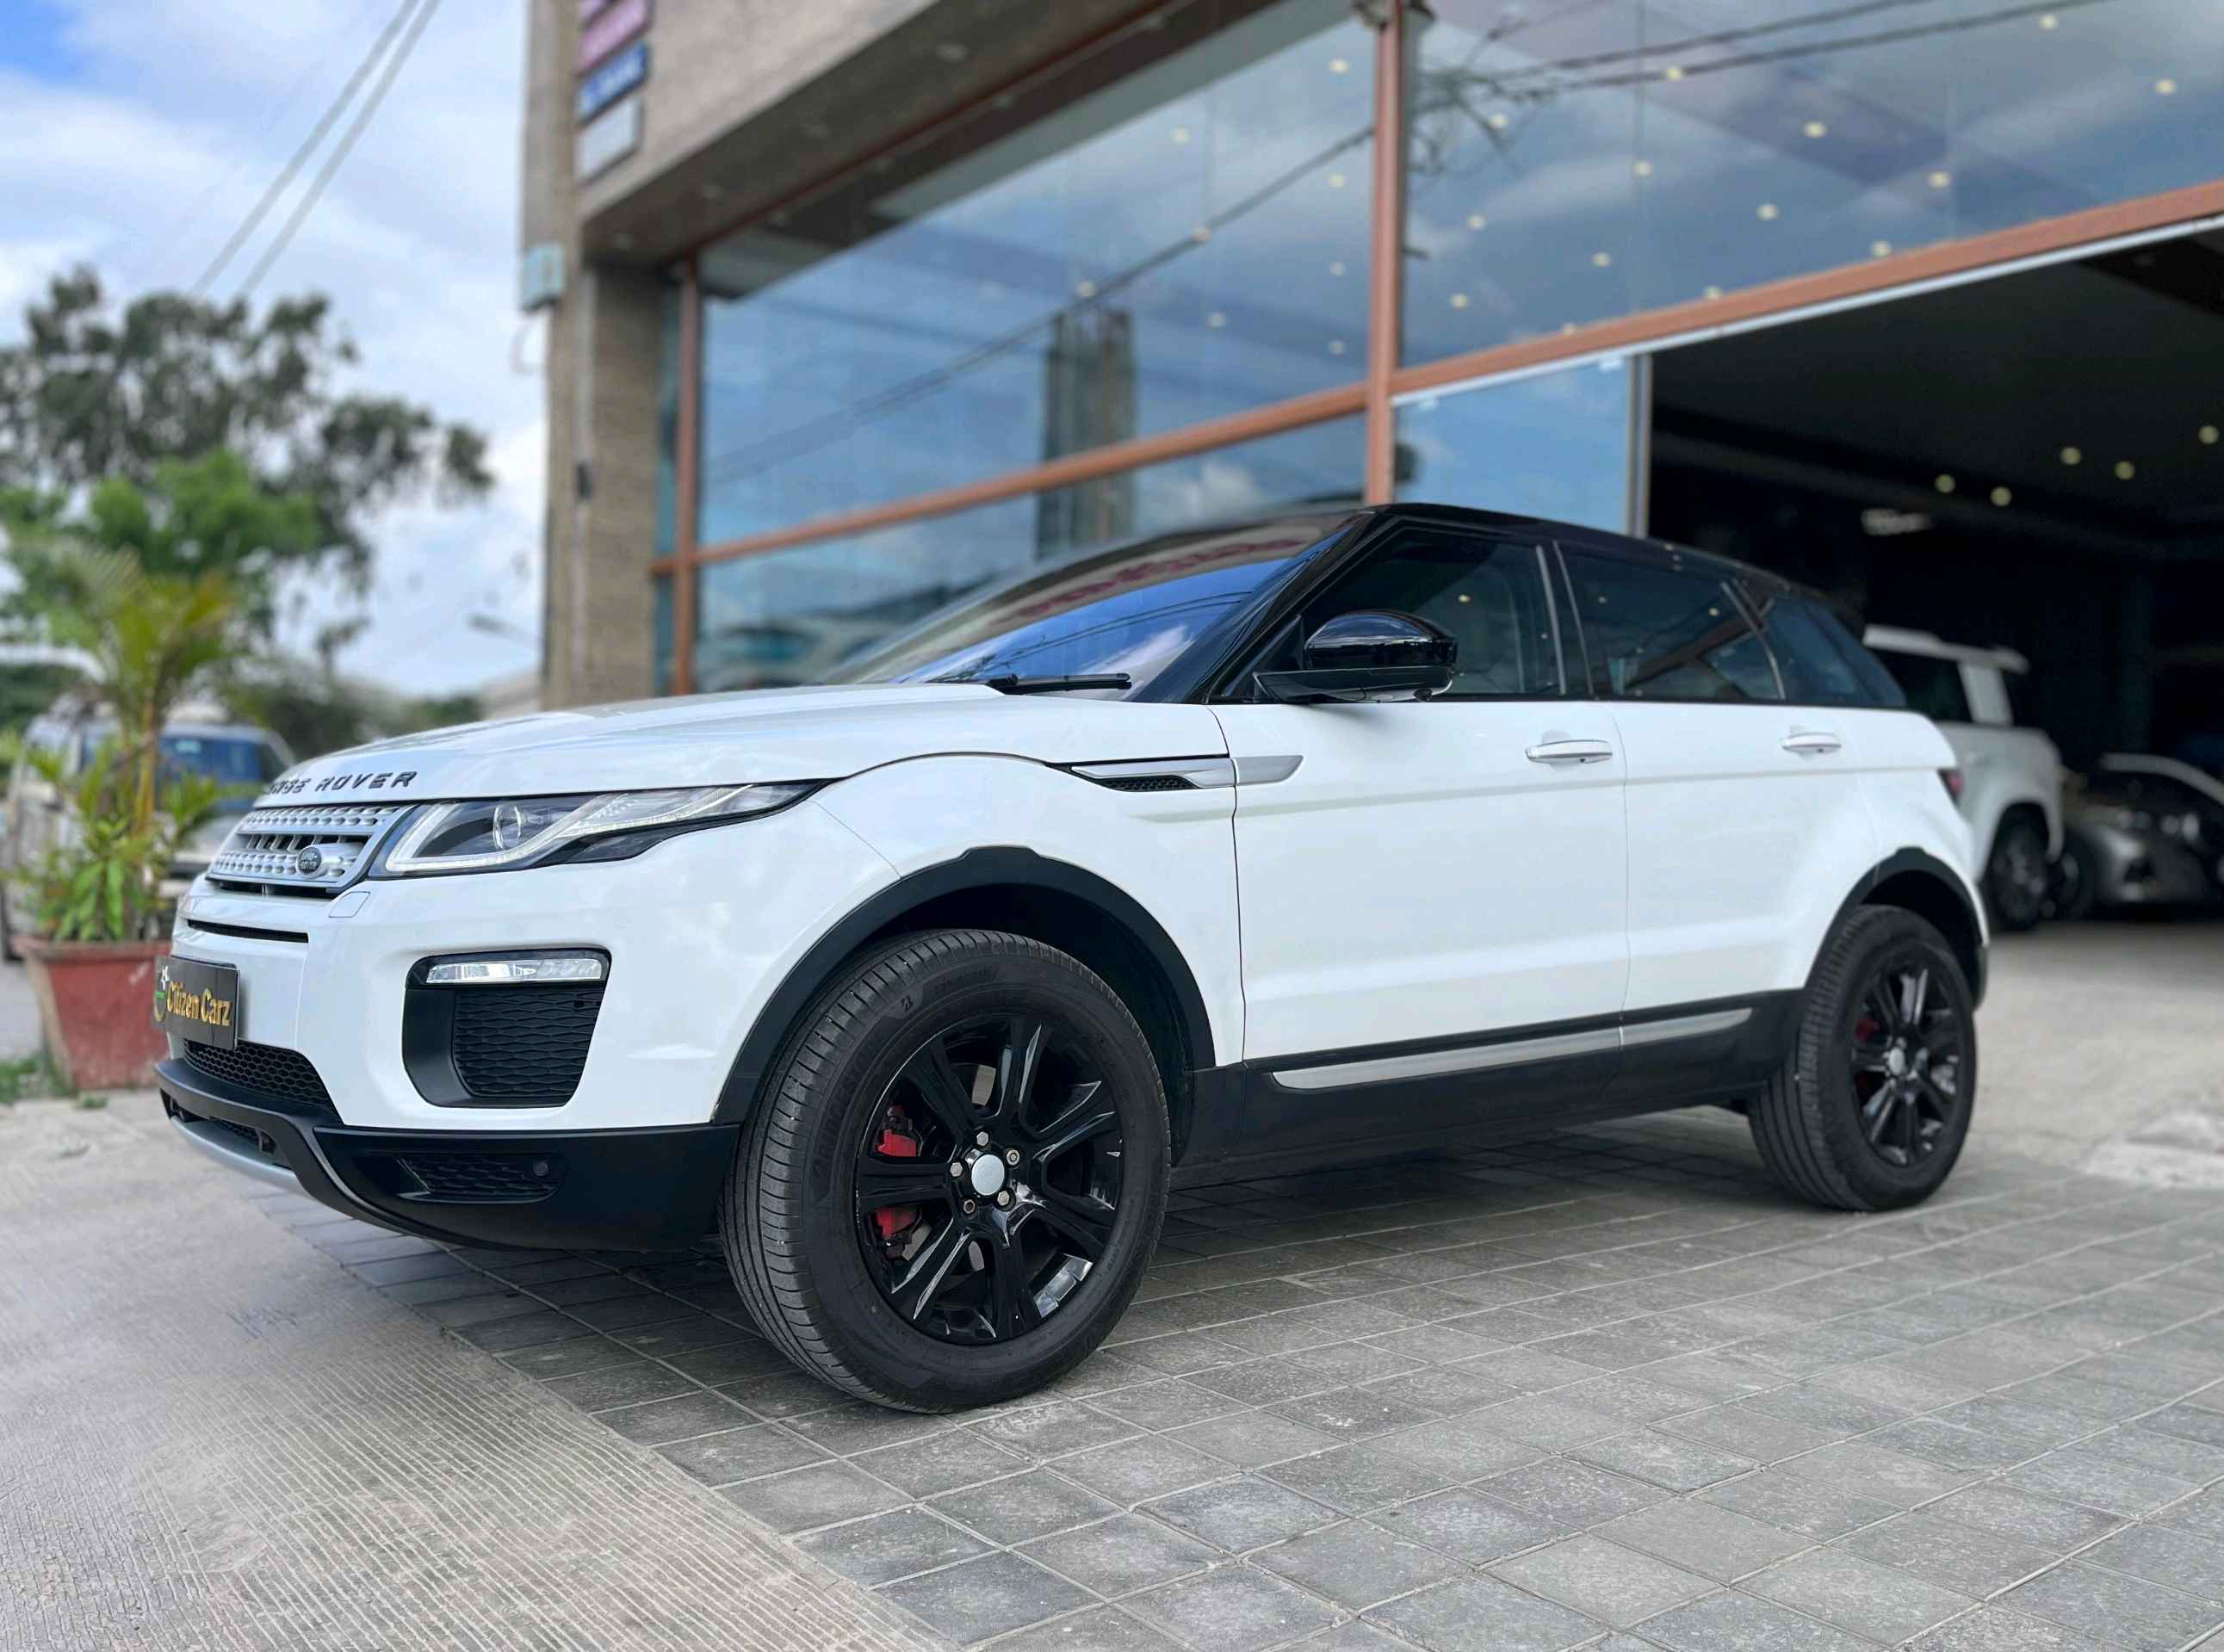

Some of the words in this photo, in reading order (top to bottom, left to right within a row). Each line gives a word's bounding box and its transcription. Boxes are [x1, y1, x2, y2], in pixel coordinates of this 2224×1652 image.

[314, 771, 418, 792] ROVER
[167, 981, 200, 1020] Citizen
[201, 988, 233, 1026] Carz
